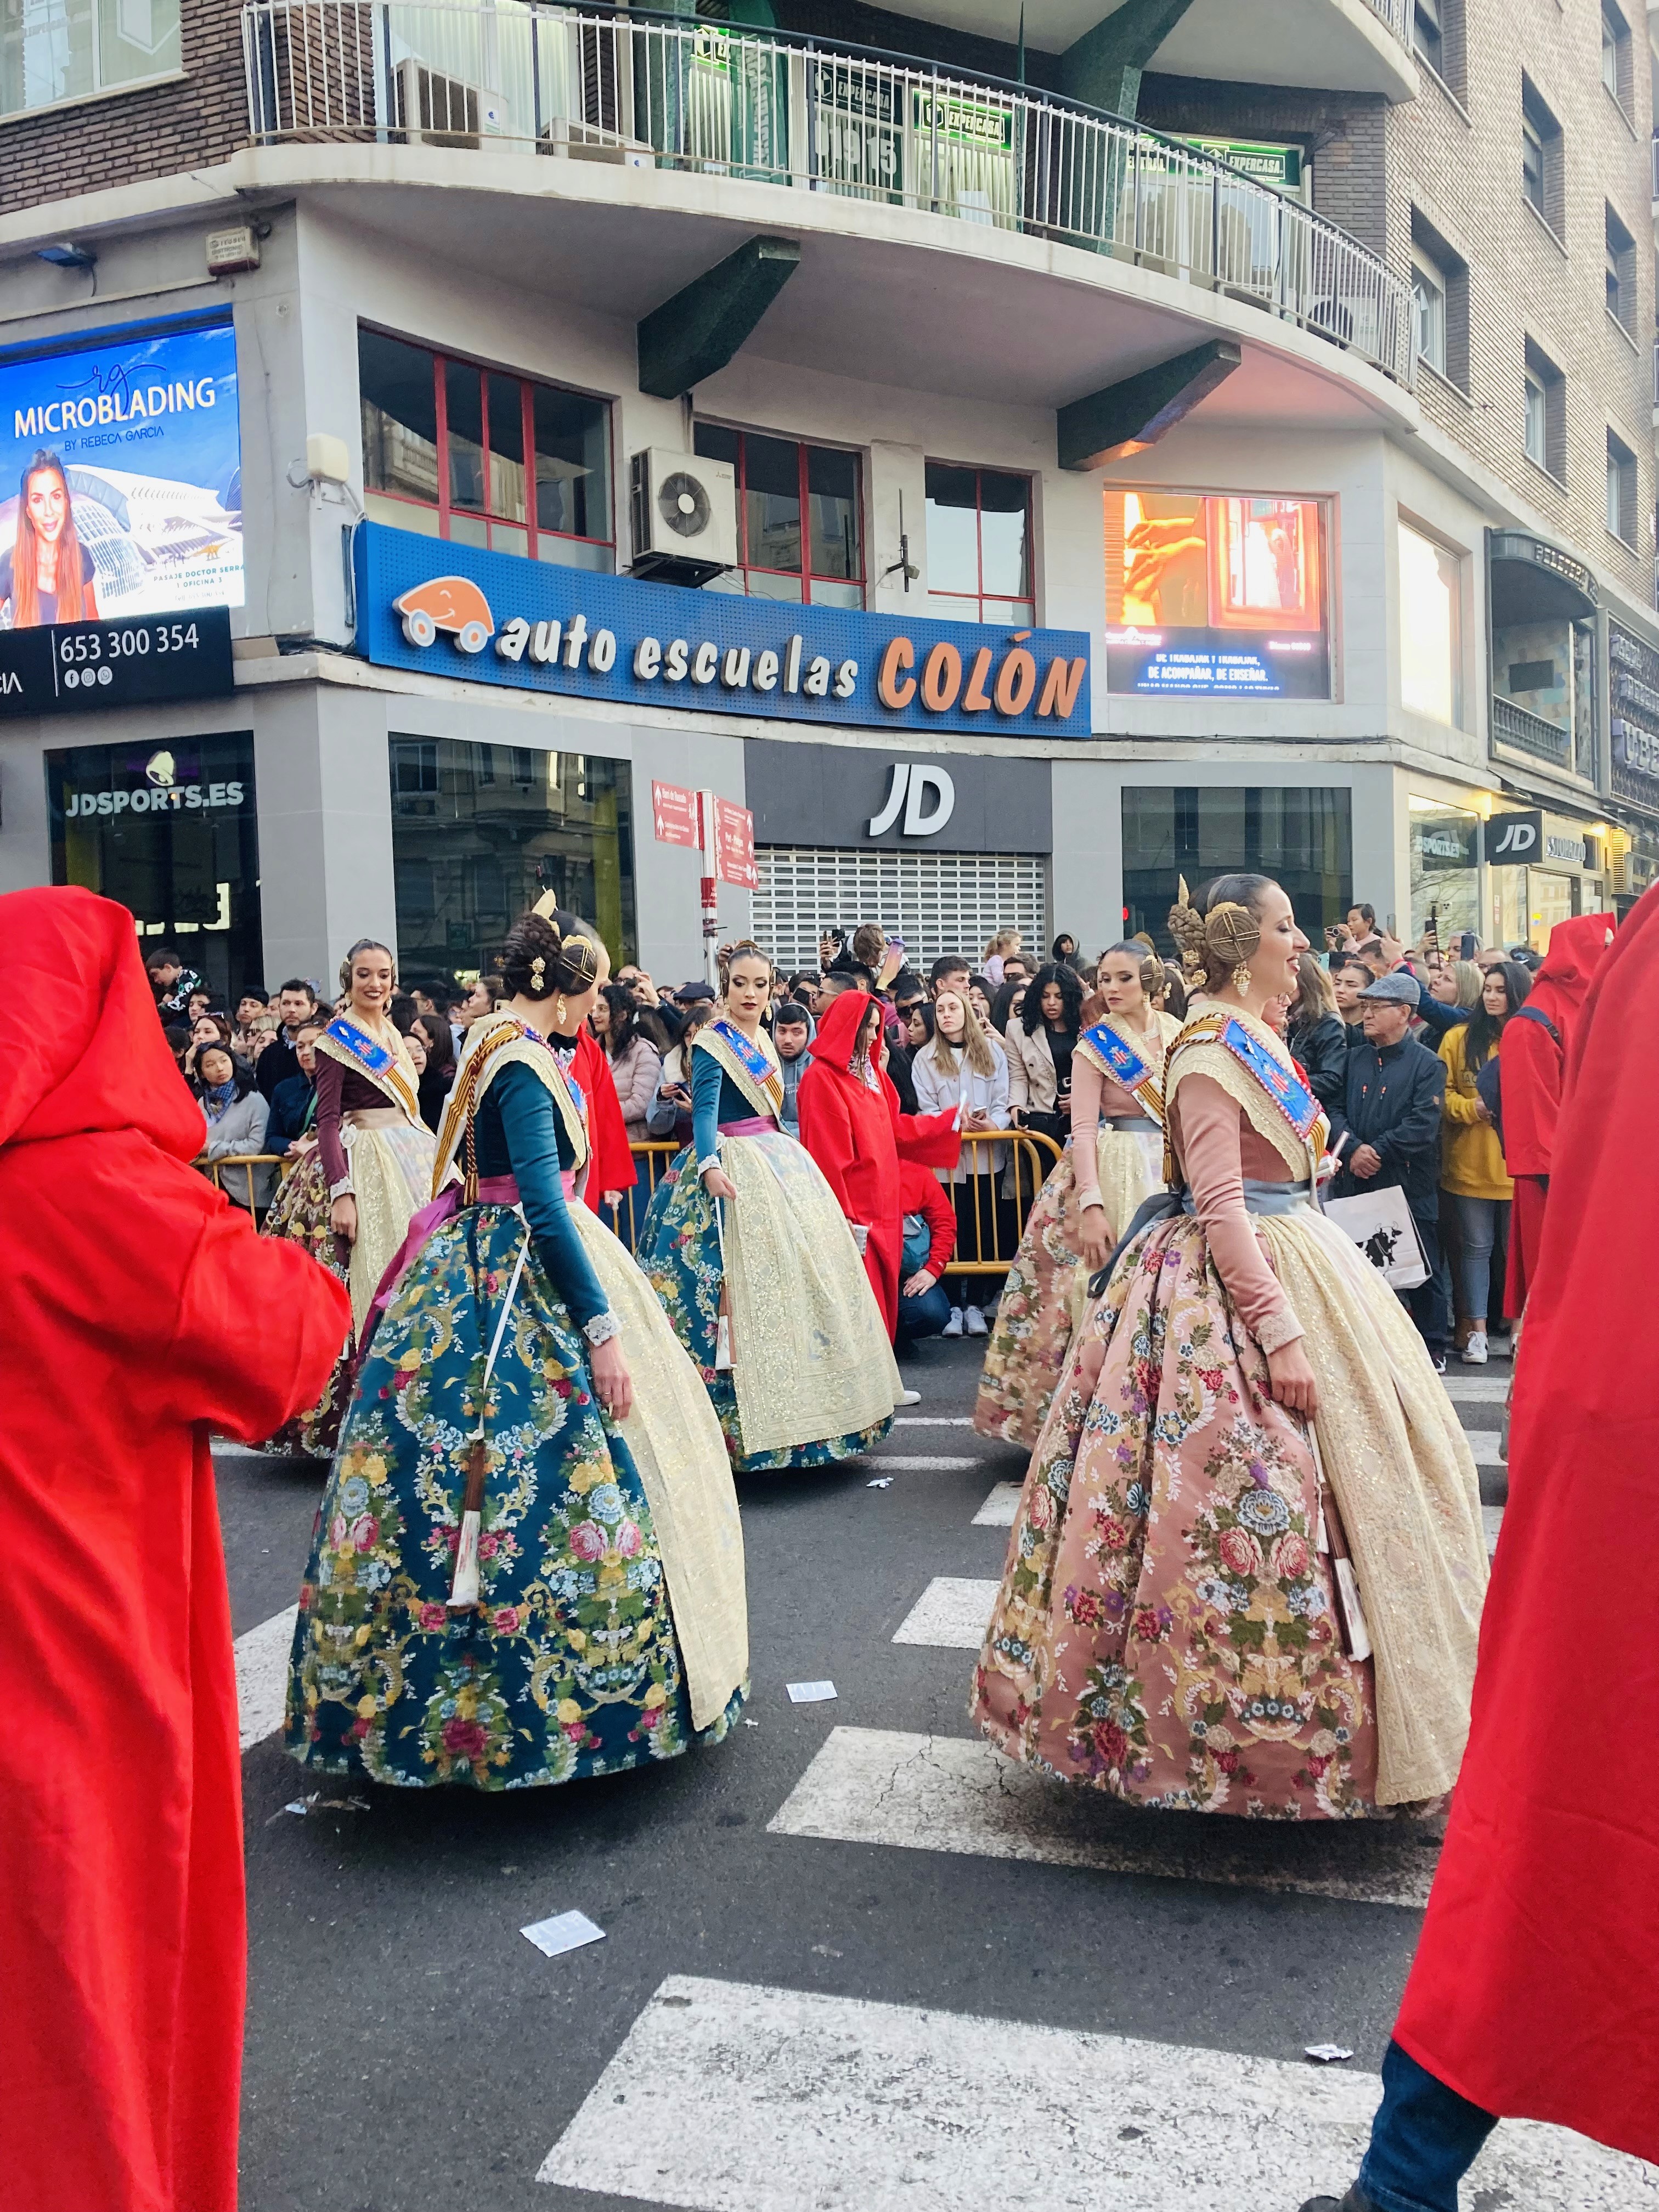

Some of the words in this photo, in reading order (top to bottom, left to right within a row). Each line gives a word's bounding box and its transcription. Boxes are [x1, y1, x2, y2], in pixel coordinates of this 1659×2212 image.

[838, 80, 891, 109] EXPERCASA
[948, 111, 1002, 137] EXPERCASA
[1229, 156, 1283, 174] EXPERCASA
[14, 377, 216, 438] MICROBLADING
[64, 441, 76, 452] BY
[81, 433, 122, 449] REBECA
[126, 426, 165, 442] GARCIA
[154, 573, 182, 582] PASAJE
[185, 568, 217, 578] DOCTOR
[219, 564, 245, 573] SERRA
[183, 578, 215, 588] OFICINA
[60, 634, 101, 663] 653
[108, 628, 150, 658] 300
[156, 623, 199, 653] 354
[495, 613, 617, 673] auto
[633, 634, 858, 698] escuelas
[878, 630, 1087, 719] COLÓN
[1148, 666, 1160, 678] DE
[1161, 665, 1214, 681] ACOMPAÑAR,
[1216, 668, 1227, 680] DE
[65, 781, 244, 817] JDSPORTS.ES
[869, 763, 956, 837] JD
[1496, 823, 1536, 853] JD
